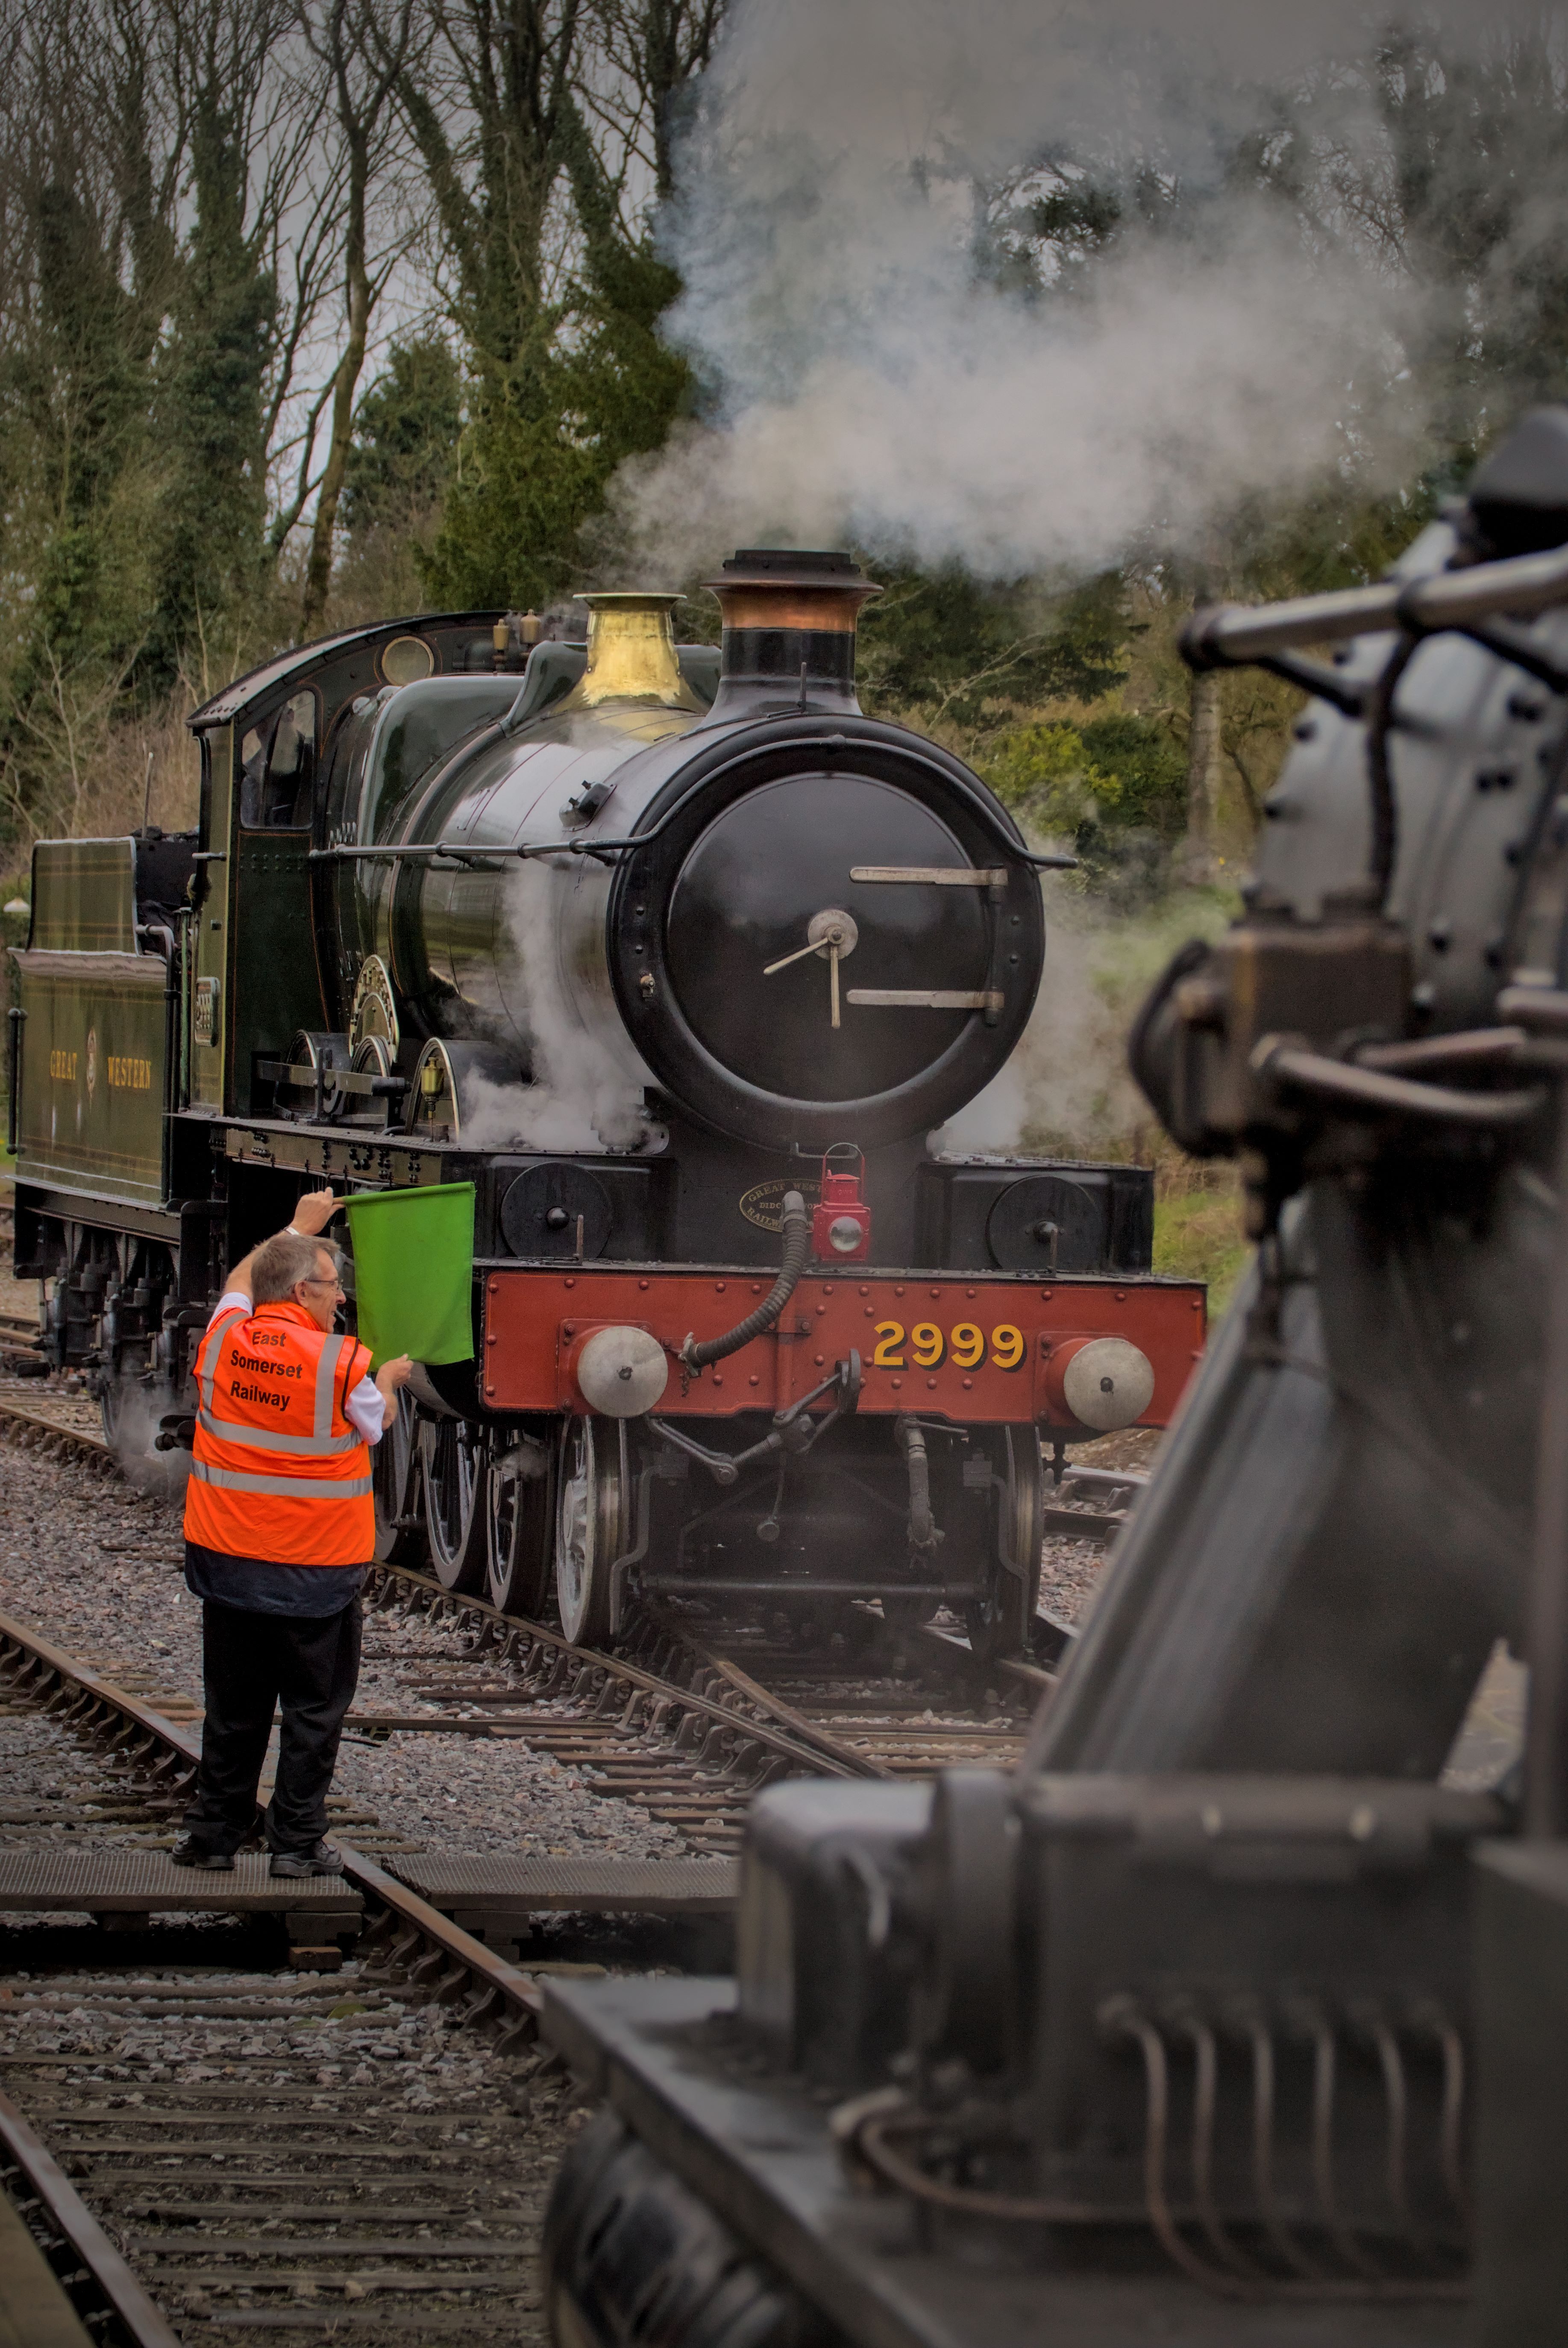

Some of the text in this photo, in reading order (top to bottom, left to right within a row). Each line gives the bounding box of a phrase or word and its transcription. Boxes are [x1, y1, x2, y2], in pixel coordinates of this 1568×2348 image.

[50, 1050, 151, 1089] GREAT WESTERN
[748, 1182, 822, 1202] GREAT WEST
[747, 1207, 780, 1227] RAILW
[252, 1331, 286, 1347] East
[874, 1321, 1027, 1373] 2999
[230, 1350, 303, 1379] Somerset
[230, 1381, 291, 1412] Railway
